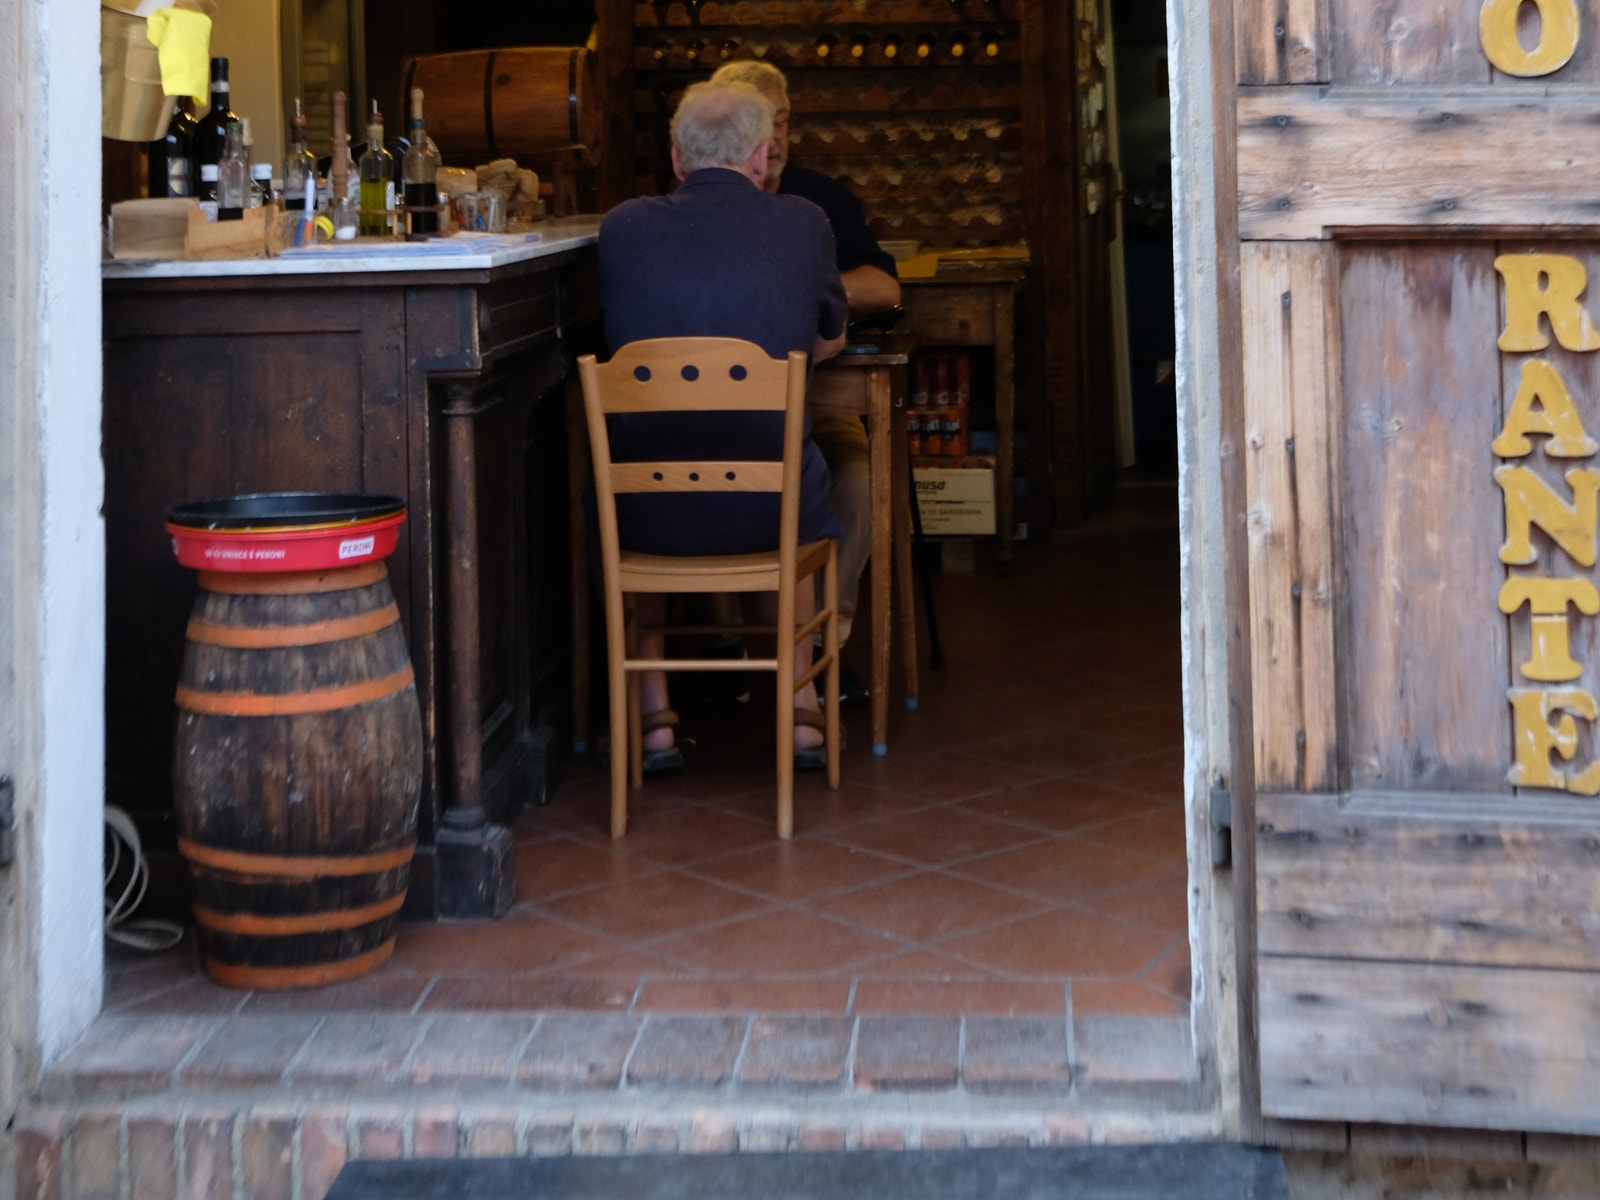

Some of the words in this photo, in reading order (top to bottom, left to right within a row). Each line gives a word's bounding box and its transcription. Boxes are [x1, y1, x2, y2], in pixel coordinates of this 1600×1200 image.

[914, 480, 945, 490] nusa
[1492, 253, 1600, 796] RANTE
[255, 548, 286, 559] PERONI
[342, 541, 372, 554] PERONI
